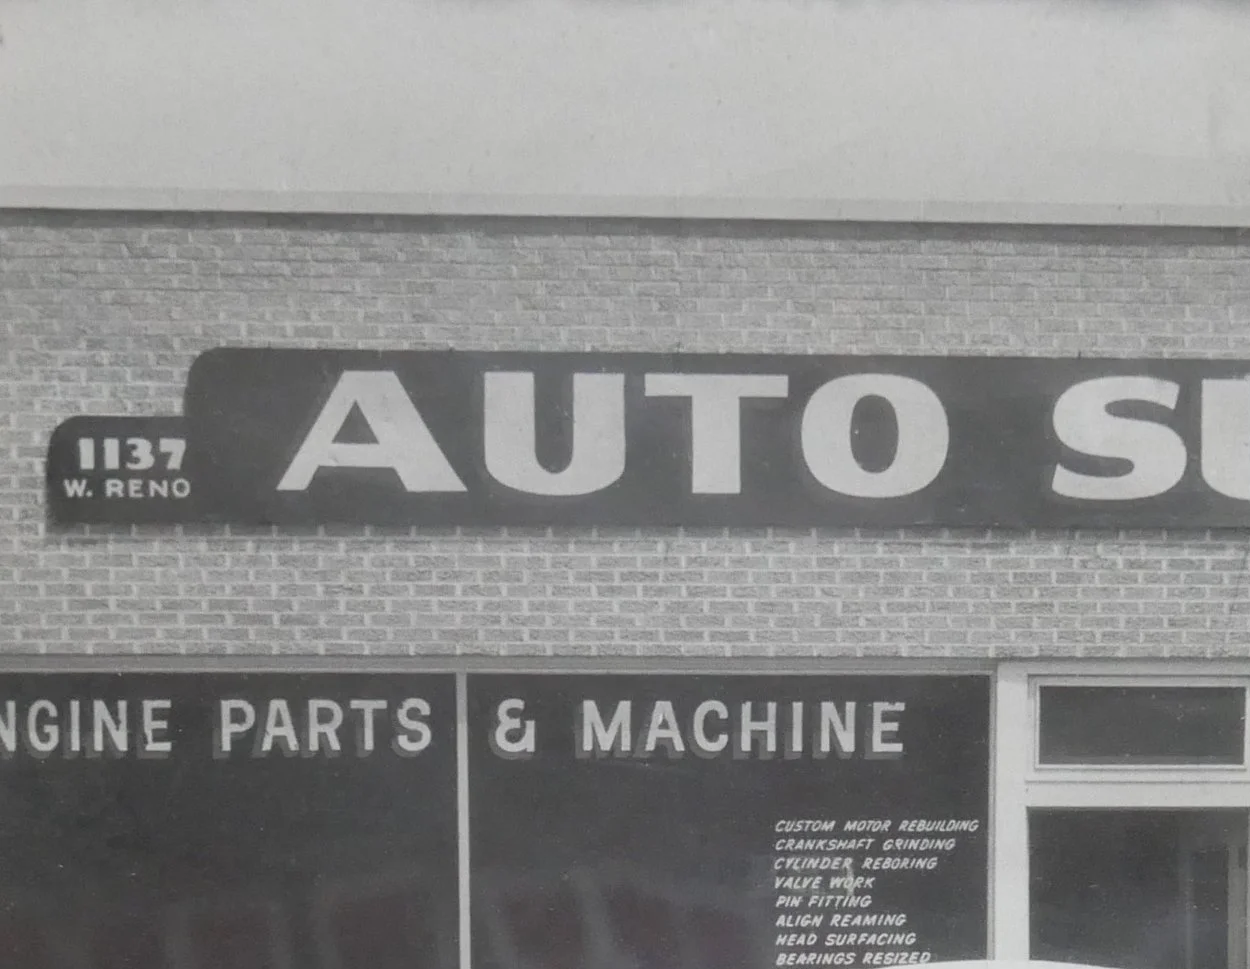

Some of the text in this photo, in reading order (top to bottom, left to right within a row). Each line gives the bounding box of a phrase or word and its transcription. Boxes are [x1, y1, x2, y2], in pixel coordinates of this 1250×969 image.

[276, 370, 949, 499] AUTO
[78, 437, 187, 471] 1137
[63, 478, 192, 498] W. RENO
[220, 698, 432, 752] PARTS
[494, 698, 536, 753] &
[582, 699, 906, 753] MACHINE
[775, 819, 980, 832] CUSTOM MOTOR REBUILDING
[775, 838, 956, 851] CRANKSHAFT GRINDING
[774, 857, 938, 870] CYLINDER REBORING
[774, 876, 875, 889] VALVE WORK
[775, 895, 872, 908] PIN FITTING
[776, 914, 907, 927] ALIGN REAMING
[776, 933, 917, 946] HEAD SURFACING
[776, 952, 856, 966] BEARINGS
